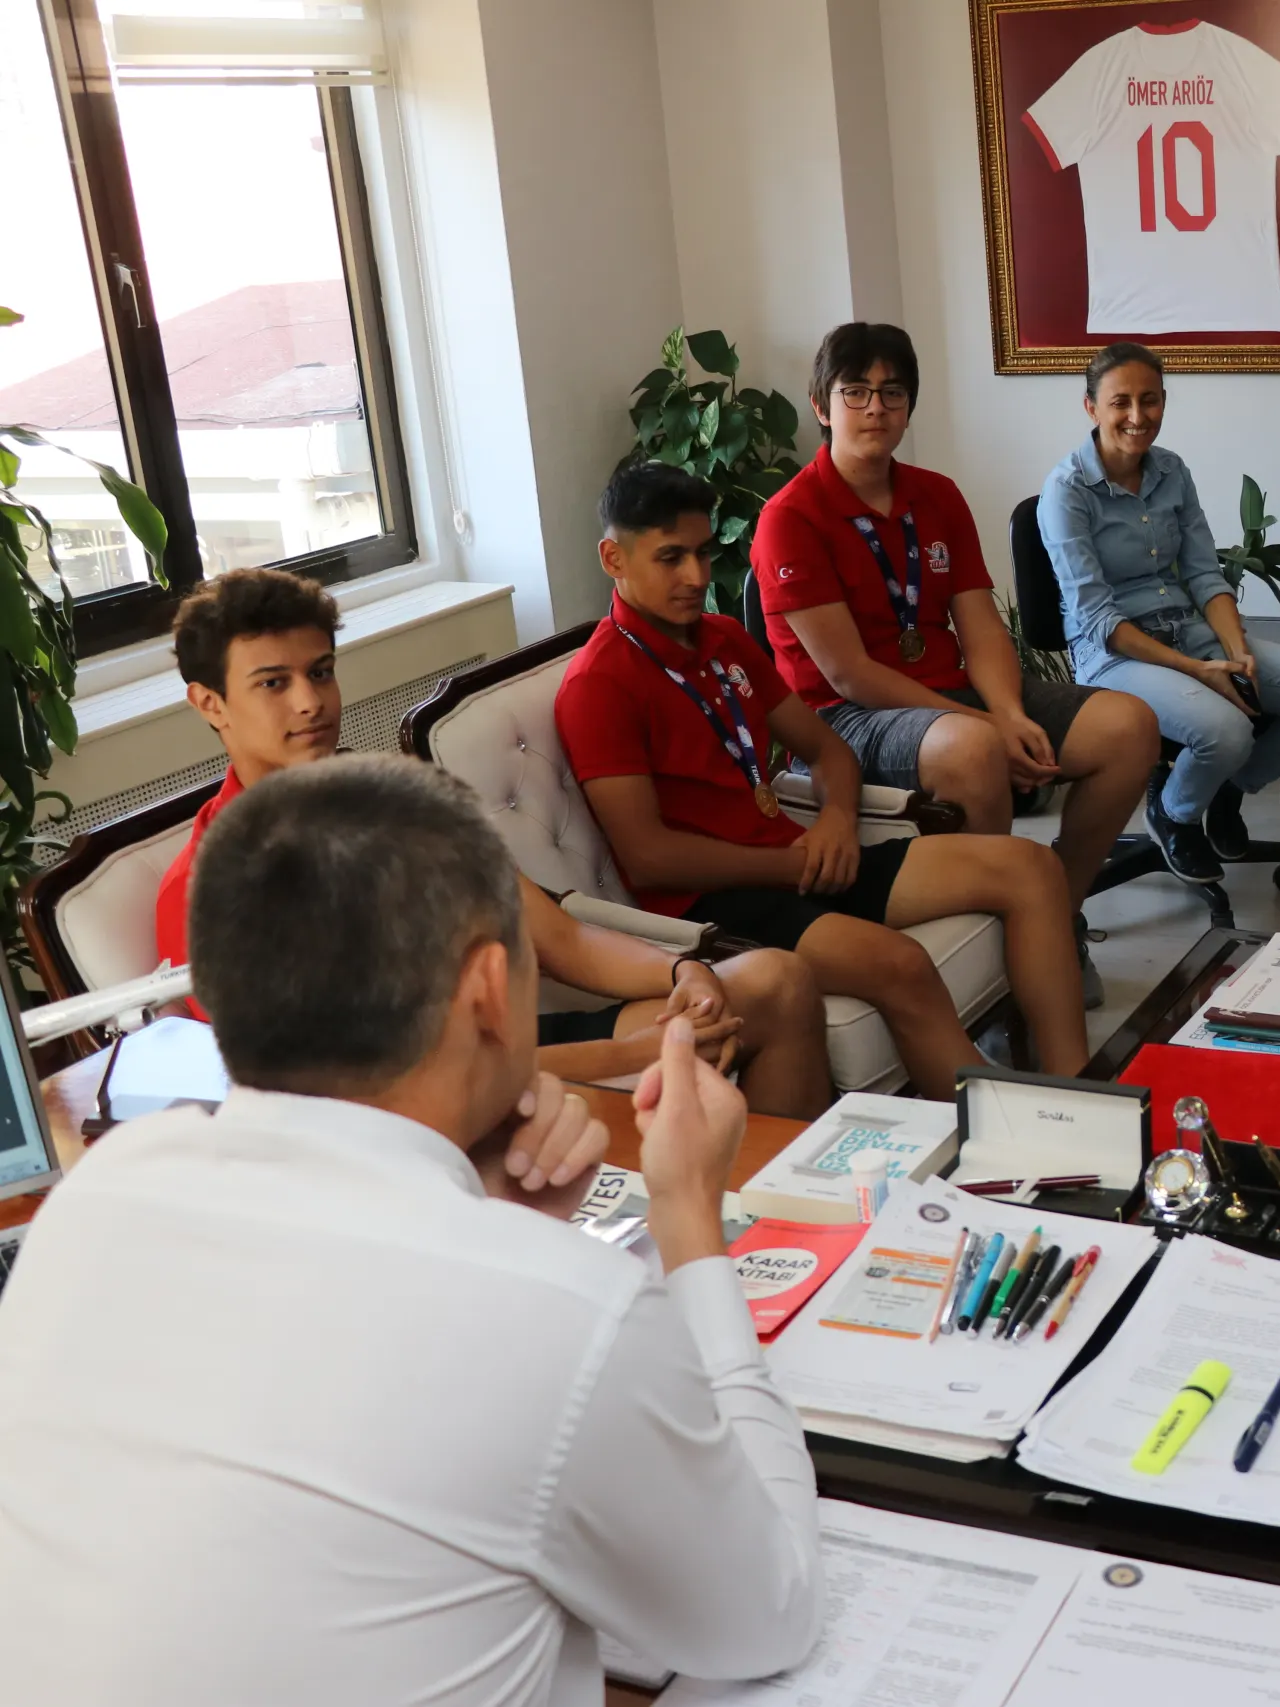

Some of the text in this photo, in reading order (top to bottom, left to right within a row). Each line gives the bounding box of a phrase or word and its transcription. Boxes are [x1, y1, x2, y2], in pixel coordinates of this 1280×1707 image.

[1127, 75, 1214, 106] ÖMER ARIÖZ
[1137, 121, 1217, 232] 10
[743, 1254, 814, 1269] KARAR
[736, 1266, 797, 1281] KİTABI
